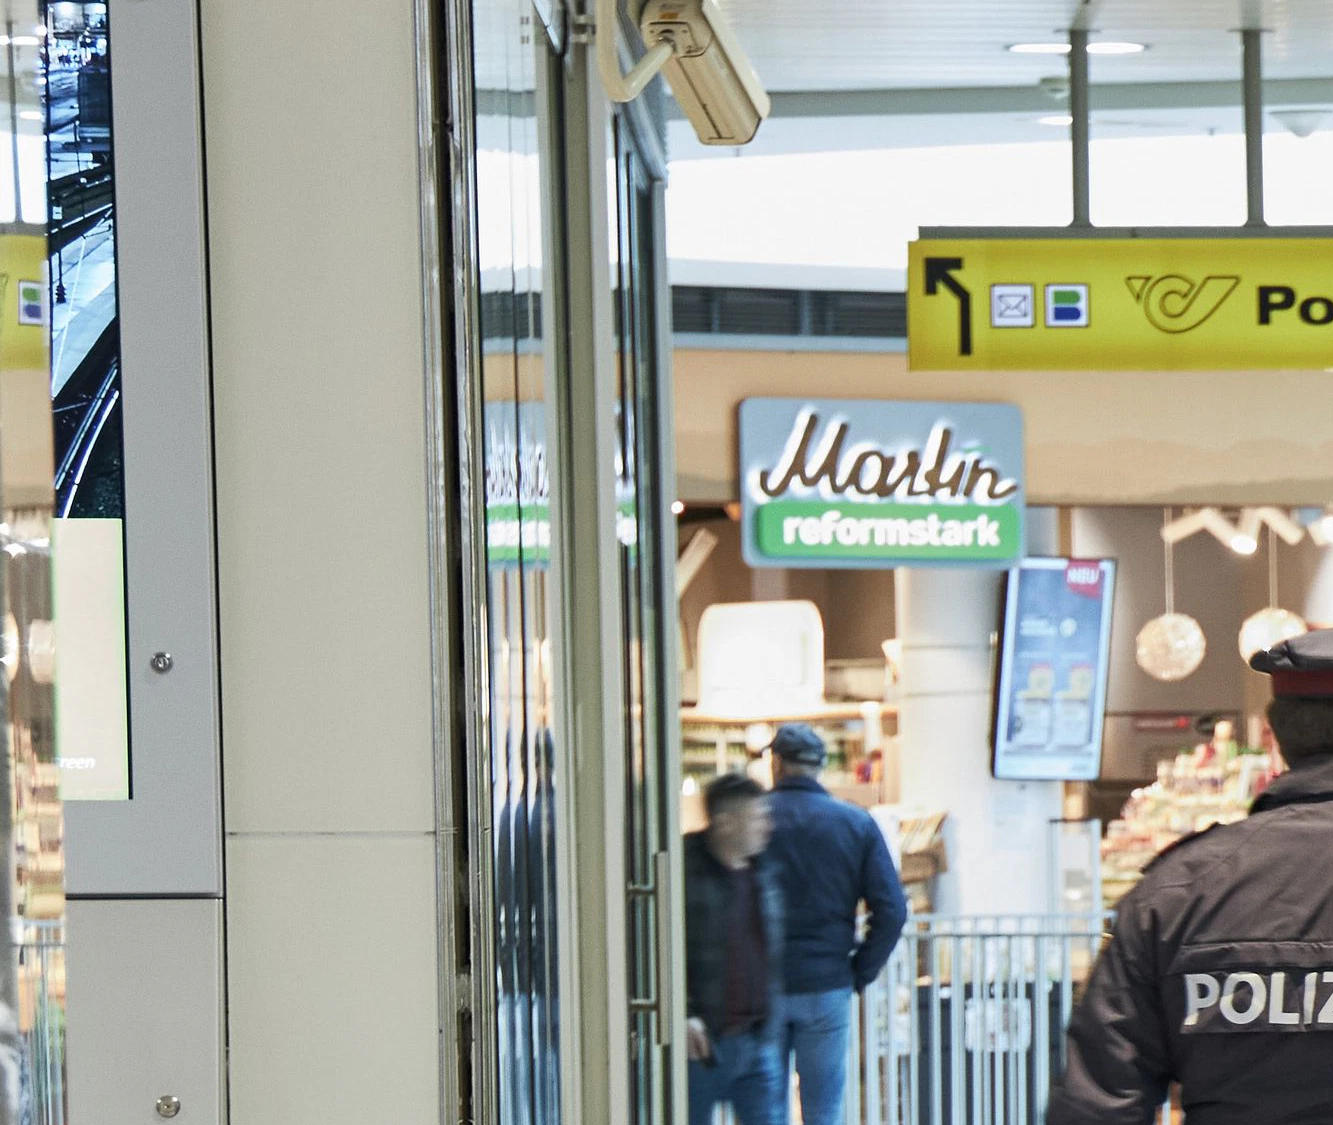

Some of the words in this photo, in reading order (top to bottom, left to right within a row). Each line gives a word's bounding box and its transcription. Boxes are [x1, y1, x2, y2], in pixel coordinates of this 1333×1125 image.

[758, 408, 1017, 500] Martin
[783, 510, 1000, 547] reformstark
[57, 756, 96, 769] reen
